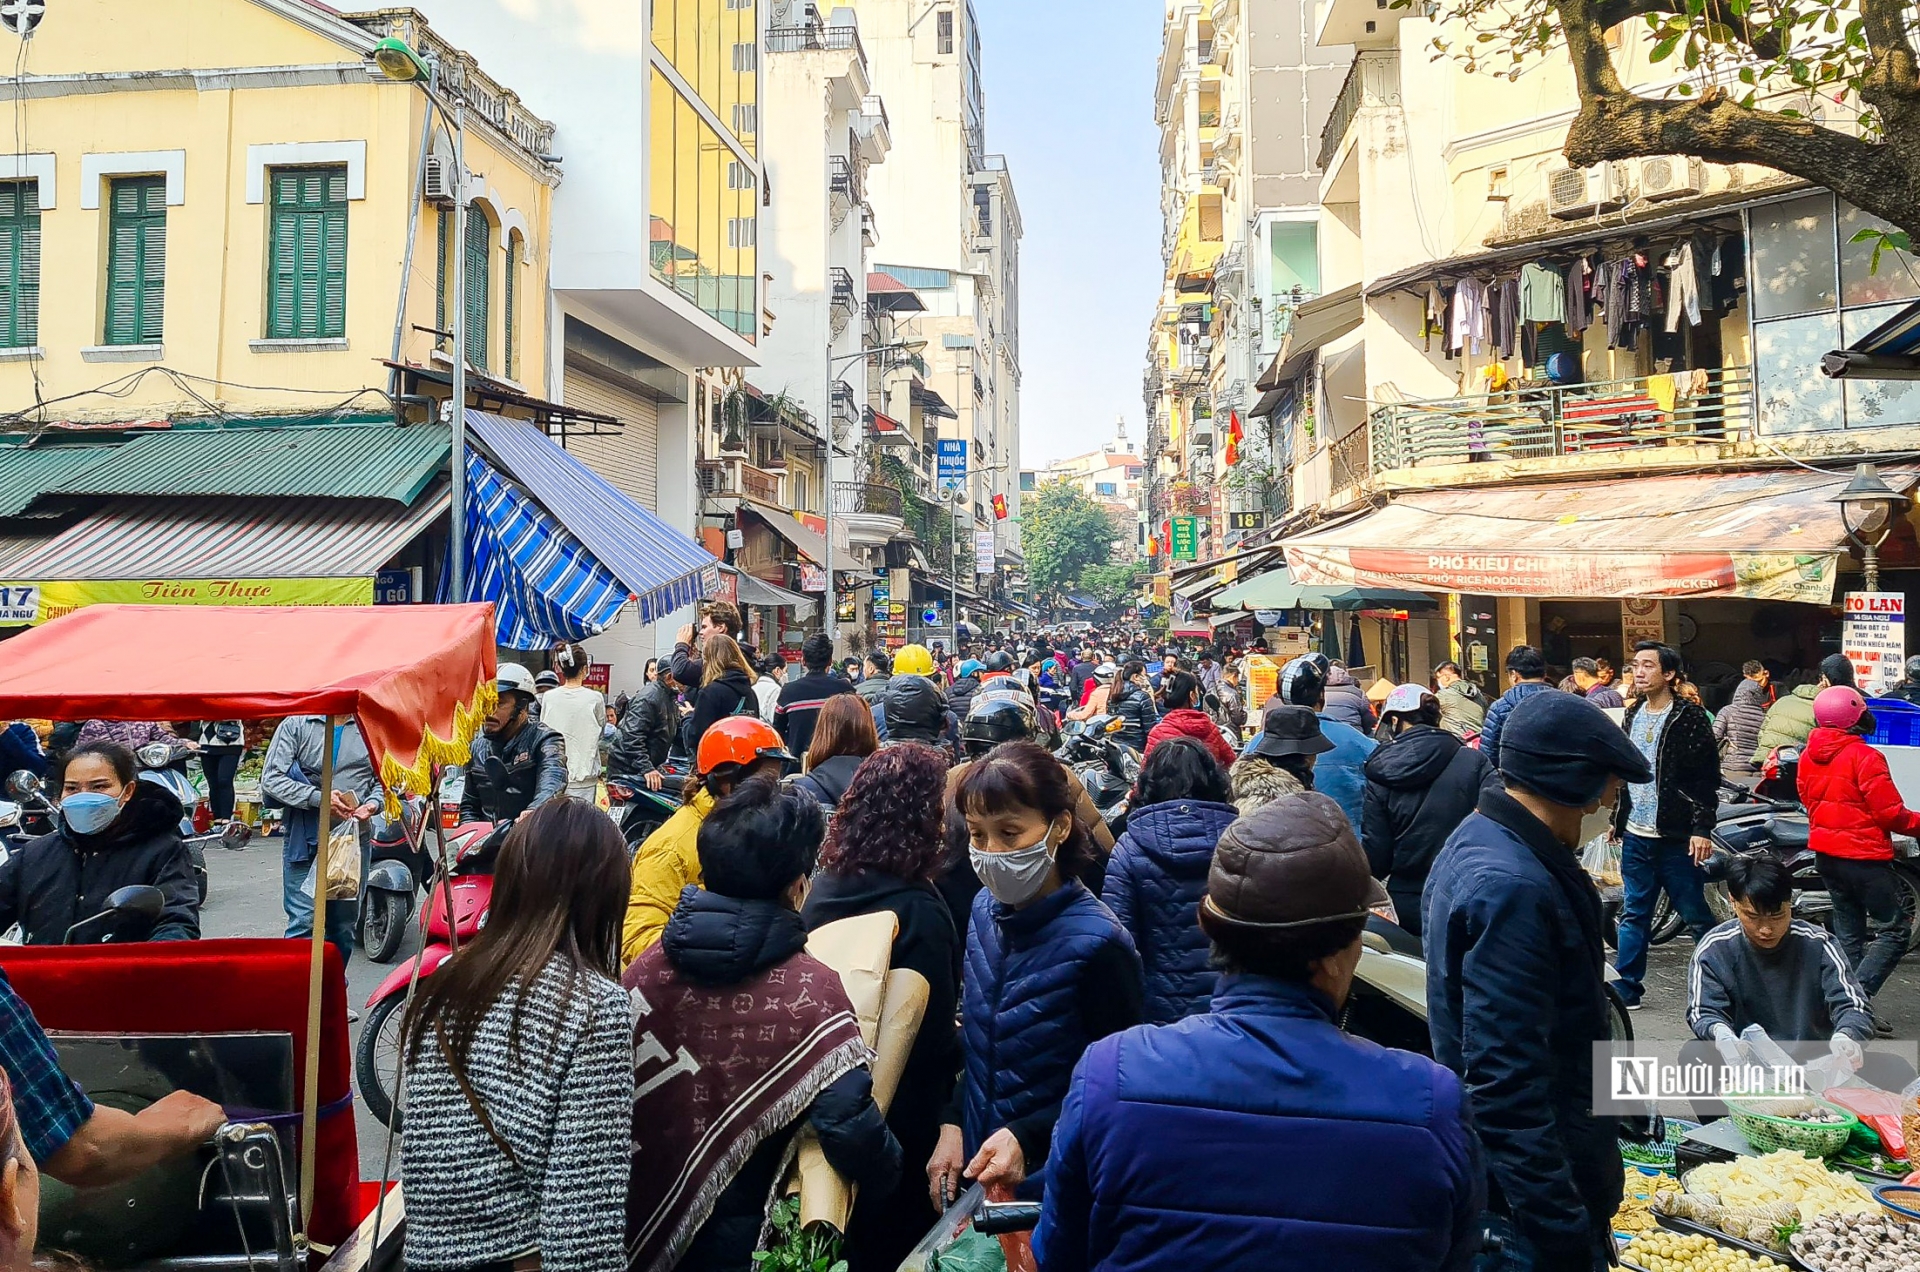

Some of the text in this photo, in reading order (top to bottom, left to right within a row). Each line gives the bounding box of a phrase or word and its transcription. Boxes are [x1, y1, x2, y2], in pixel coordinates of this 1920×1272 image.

[943, 441, 961, 452] NHÀ
[1457, 575, 1482, 585] RICE
[1484, 575, 1531, 587] NOODLE
[0, 588, 33, 606] 17
[141, 580, 273, 601] Tiền Thực
[1868, 598, 1903, 612] LAN
[1624, 617, 1636, 626] 14
